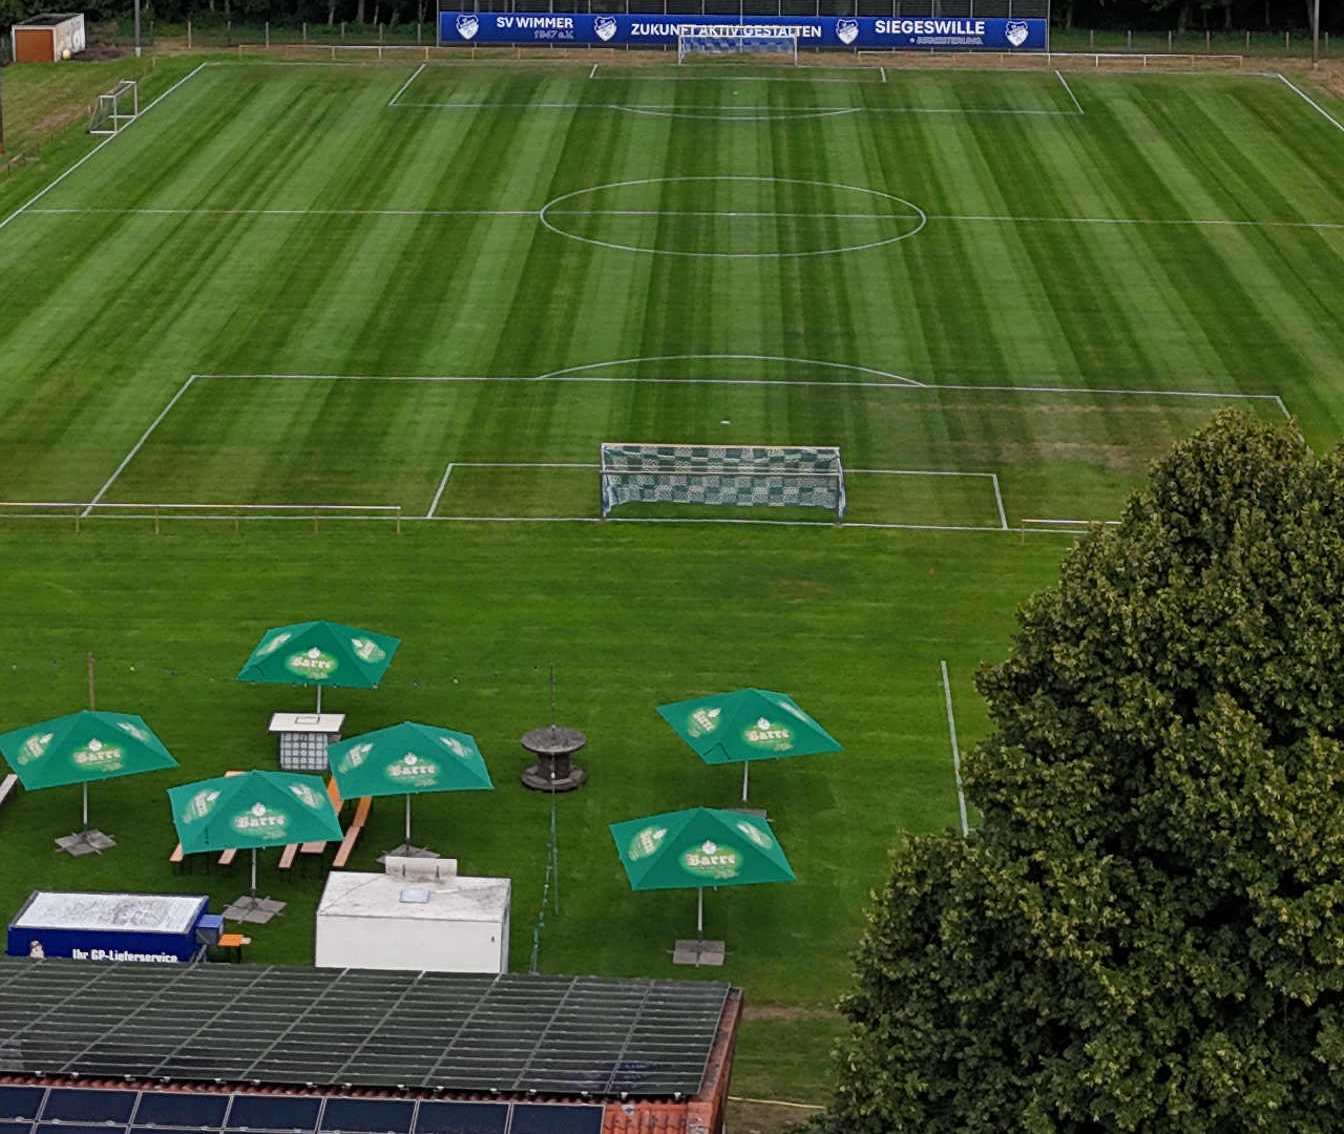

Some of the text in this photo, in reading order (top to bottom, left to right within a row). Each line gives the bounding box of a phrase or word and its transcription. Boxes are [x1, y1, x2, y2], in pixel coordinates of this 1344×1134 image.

[496, 16, 574, 29] SV WIMMER
[875, 20, 985, 35] SIEGESWILLE
[630, 23, 822, 38] ZUKUNFT AKTIV GESTALTEN
[745, 728, 790, 742] Barre
[73, 747, 122, 763] Barre
[387, 763, 437, 777] Barre
[234, 814, 287, 829] Barre
[686, 853, 737, 867] Barre
[72, 948, 178, 964] Ihr GP-Lieferservice
